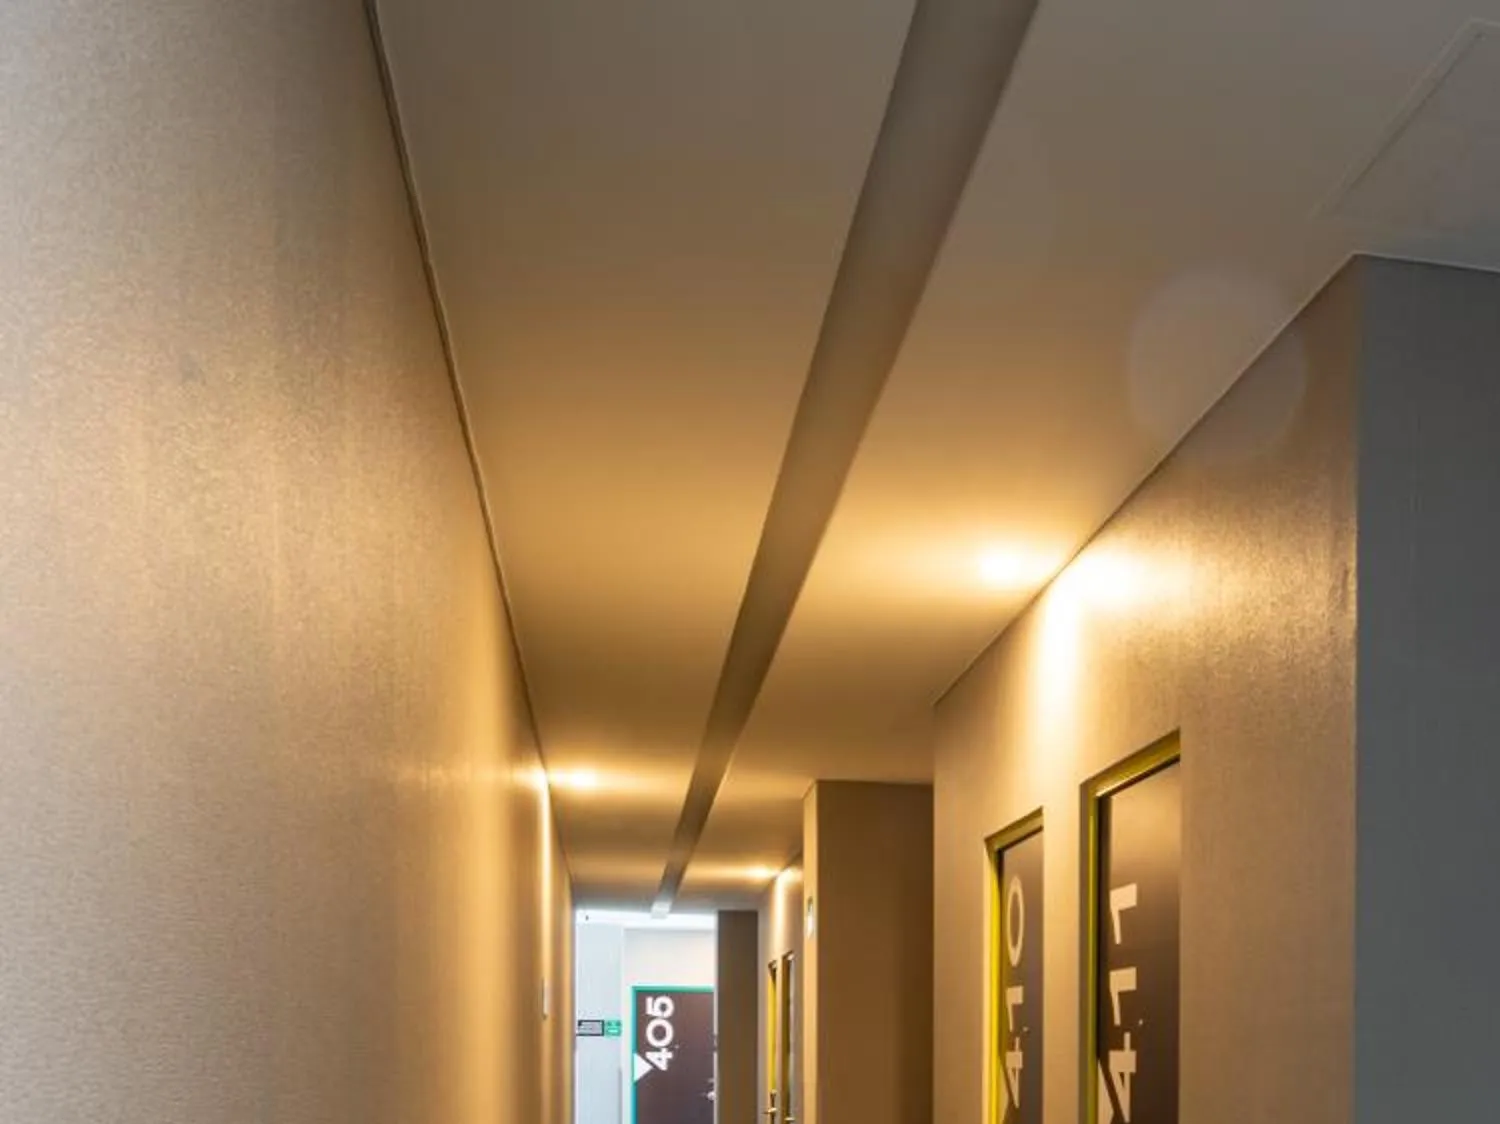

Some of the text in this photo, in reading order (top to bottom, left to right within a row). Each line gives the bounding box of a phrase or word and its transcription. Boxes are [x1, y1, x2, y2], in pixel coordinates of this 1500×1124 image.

[646, 995, 674, 1070] 405
[1006, 876, 1024, 1109] 410
[1109, 883, 1137, 1123] 411
